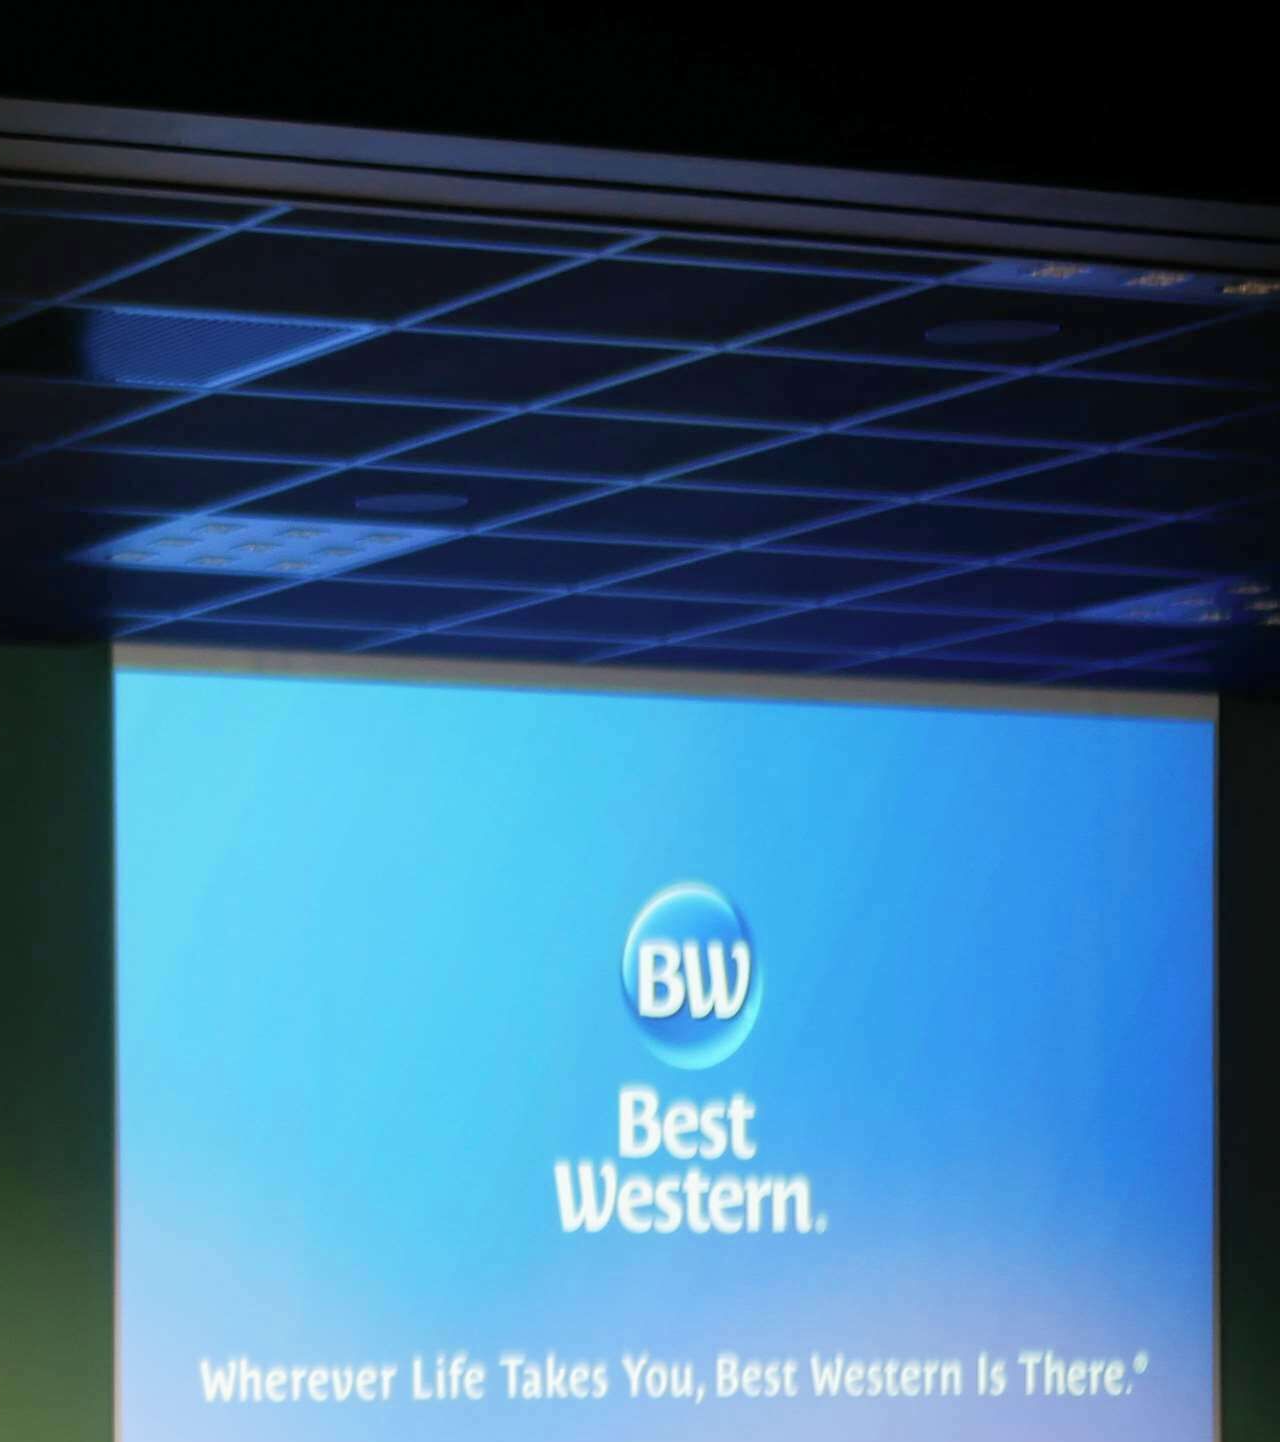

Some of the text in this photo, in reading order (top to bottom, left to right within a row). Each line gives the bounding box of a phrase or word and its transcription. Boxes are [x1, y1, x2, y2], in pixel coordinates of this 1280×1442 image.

[639, 938, 752, 1022] BW
[618, 1085, 759, 1160] Best
[200, 1354, 397, 1402] Wherever
[412, 1352, 487, 1401] Life
[500, 1352, 609, 1400] Takes
[622, 1353, 706, 1404] You,
[716, 1353, 798, 1398] Best
[811, 1354, 962, 1397] Western
[977, 1353, 1007, 1396] Is
